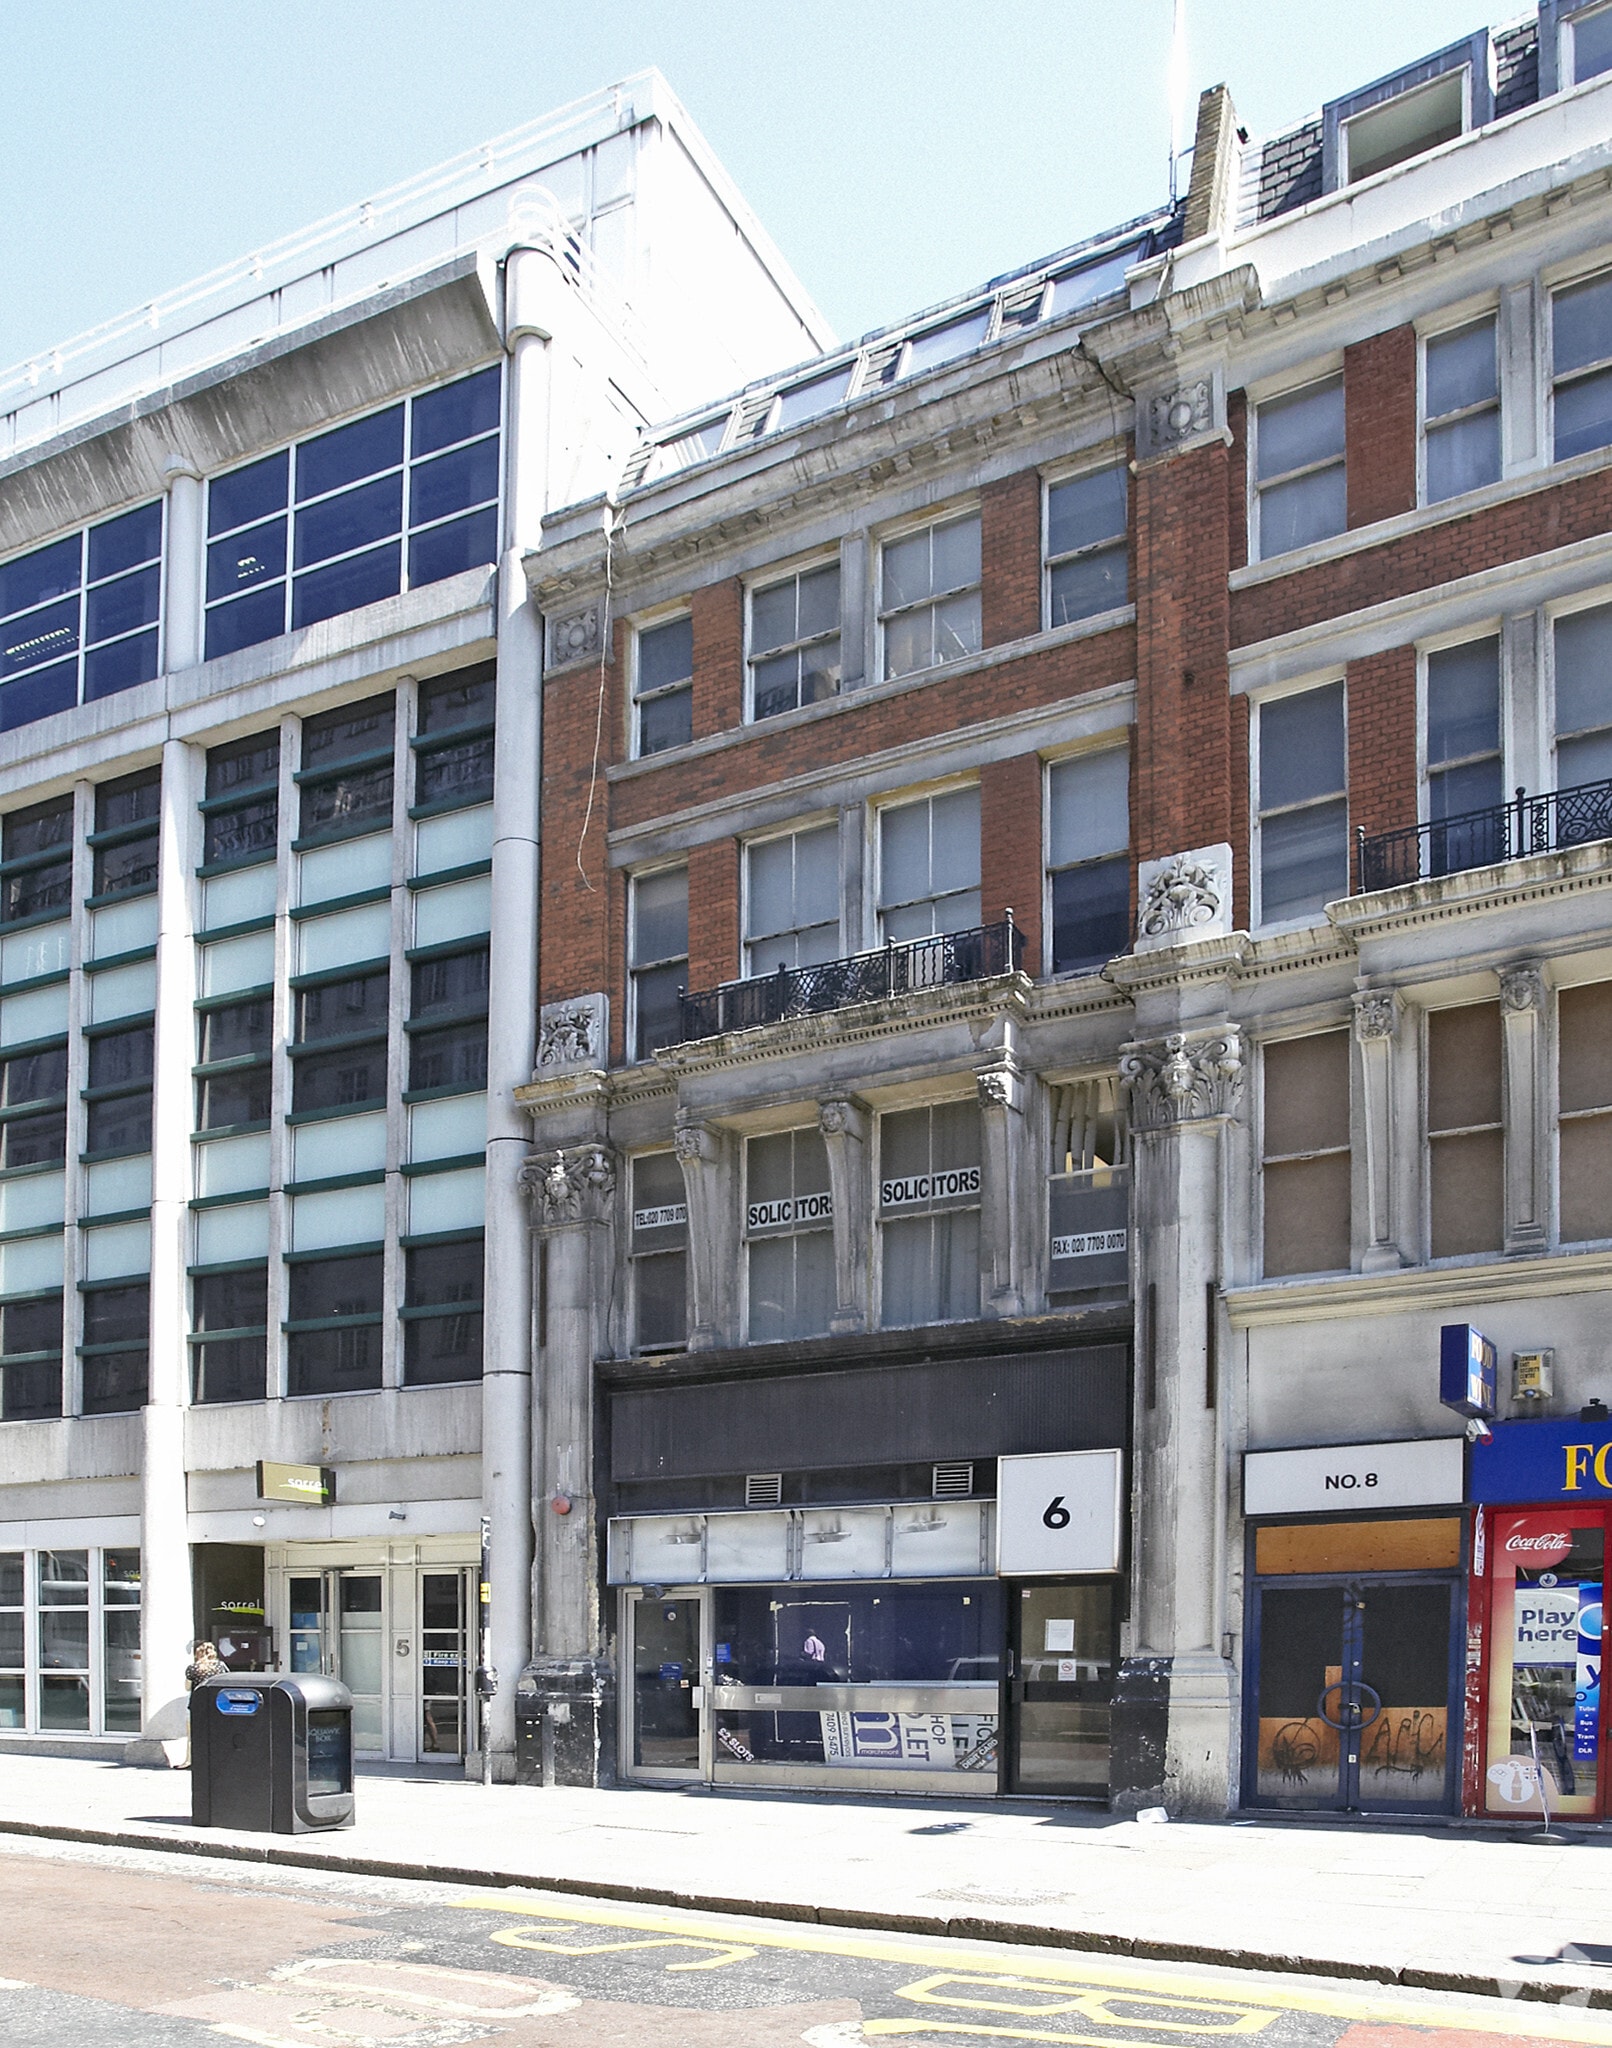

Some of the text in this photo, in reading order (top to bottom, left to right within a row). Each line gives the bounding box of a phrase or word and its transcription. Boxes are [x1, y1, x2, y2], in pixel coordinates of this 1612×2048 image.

[883, 1170, 979, 1203] SOLICITORS
[660, 1209, 674, 1222] 7709
[1053, 1233, 1124, 1255] FAX: 020 7709 0070
[288, 1478, 327, 1489] sorrel
[1043, 1496, 1070, 1529] 6
[1505, 1533, 1577, 1551] Coca-Cola
[221, 1599, 259, 1610] sorrel
[1522, 1608, 1575, 1627] Play
[1518, 1626, 1577, 1641] here
[396, 1640, 409, 1657] 5
[825, 1713, 839, 1756] 7409 5475
[843, 1727, 851, 1757] surveyors
[729, 1737, 754, 1761] SLOTS
[906, 1728, 930, 1761] LET
[979, 1739, 998, 1756] CARD
